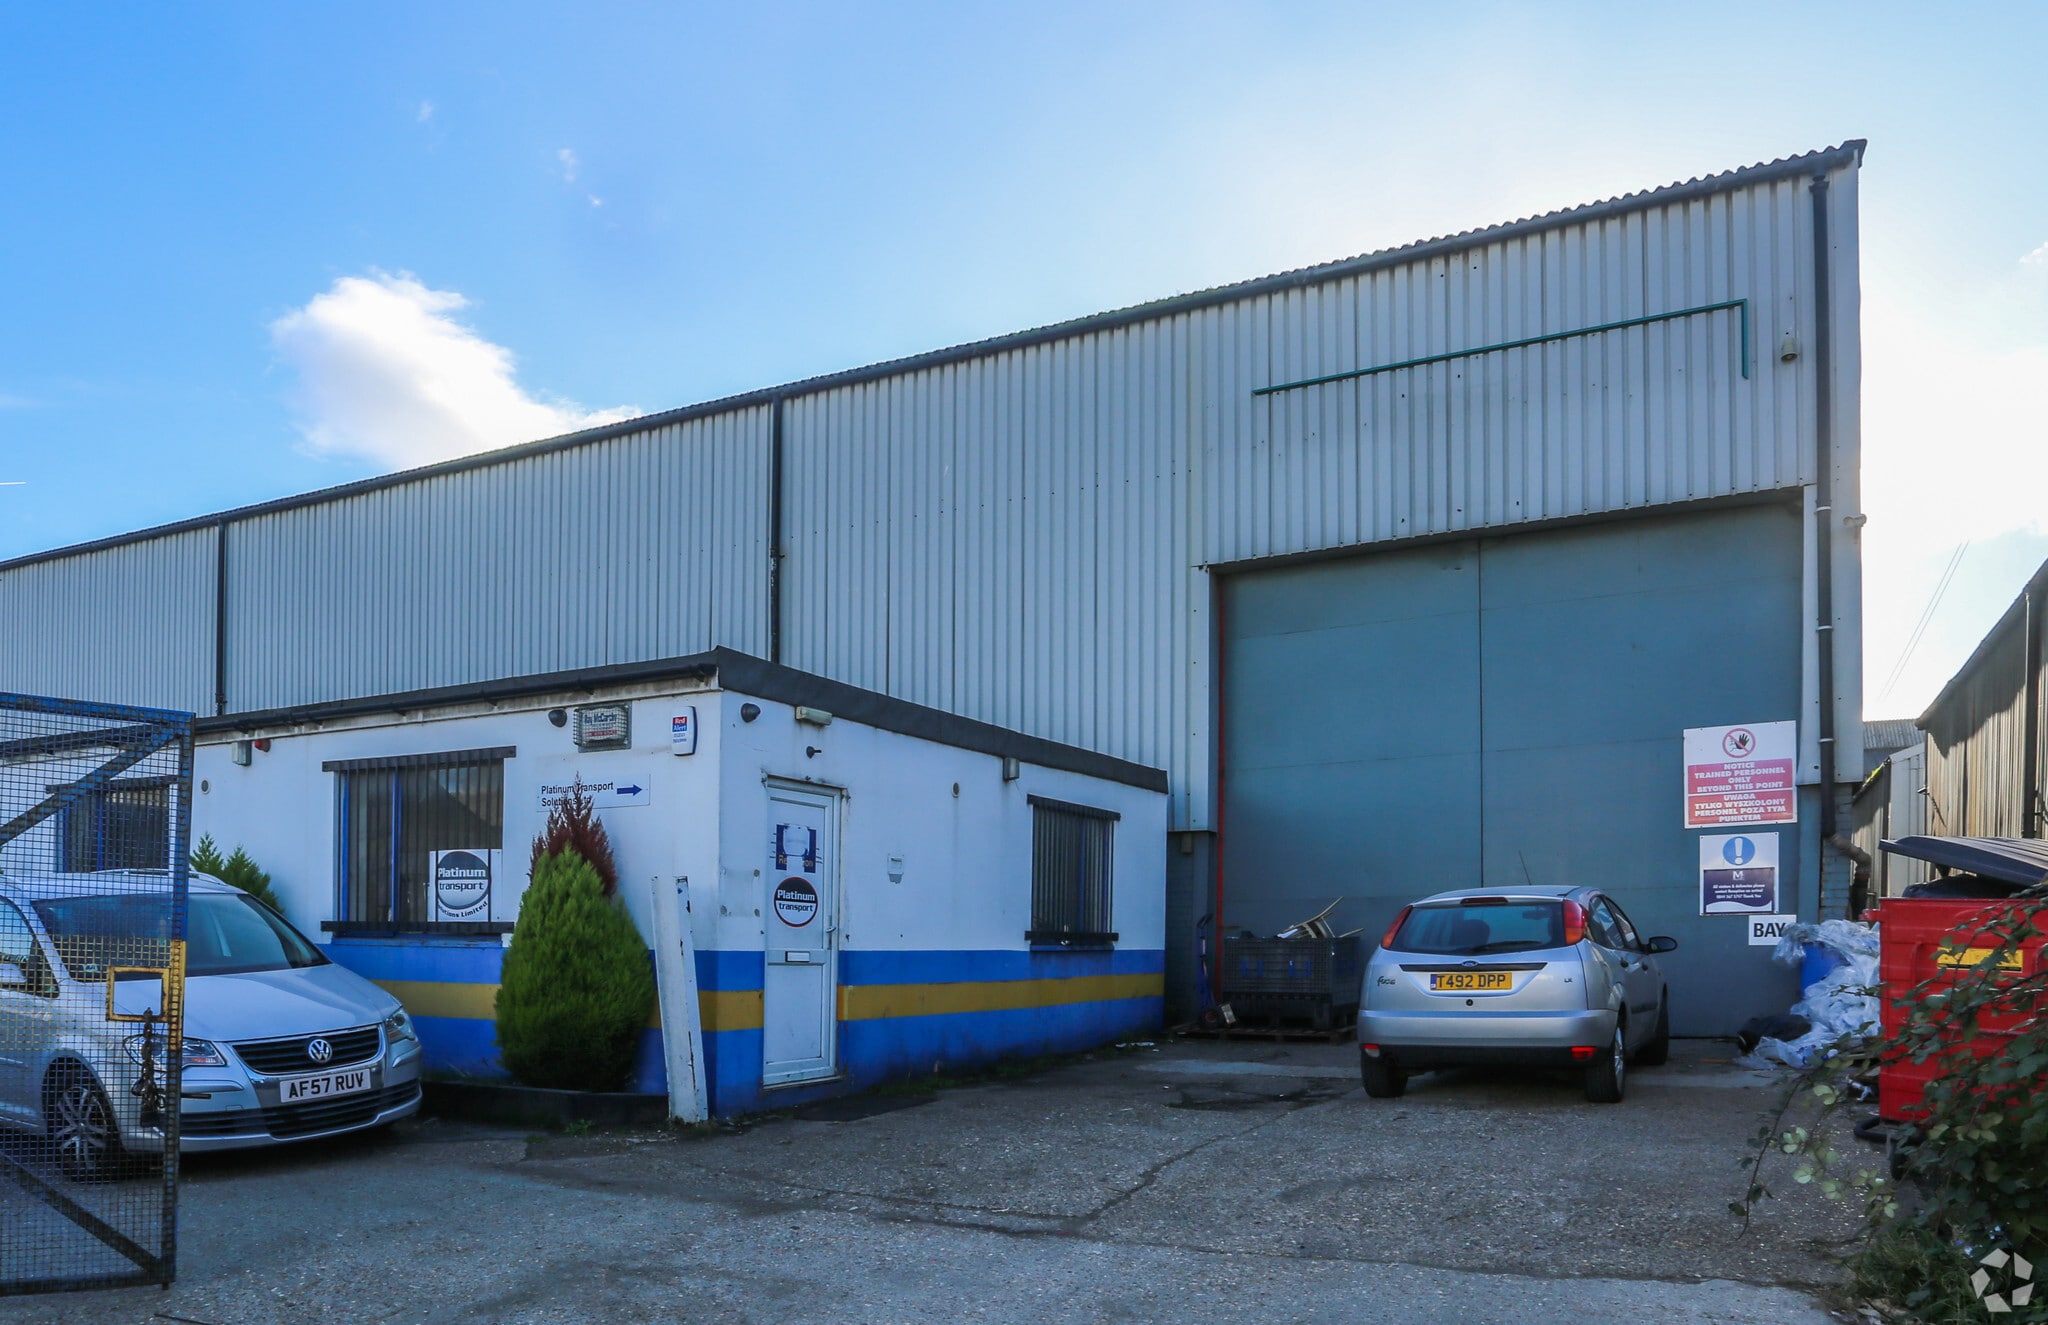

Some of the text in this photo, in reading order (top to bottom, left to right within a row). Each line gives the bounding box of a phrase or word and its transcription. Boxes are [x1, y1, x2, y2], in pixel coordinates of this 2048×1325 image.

[1724, 762, 1755, 770] NOTICE
[1694, 767, 1785, 779] TRAINED PERSONNEL
[541, 785, 574, 794] Platinum
[1697, 784, 1731, 792] BEYOND
[1756, 781, 1784, 789] POINT
[541, 797, 578, 807] Solutns
[1723, 793, 1756, 801] UWAGA
[1725, 798, 1786, 808] WYSZKOLONY
[1695, 808, 1738, 816] PERSONEL
[1719, 814, 1761, 822] PUNKTEM
[438, 867, 486, 878] Platinum
[439, 882, 485, 892] transport
[777, 889, 815, 901] Platinum
[778, 902, 813, 912] transport
[1753, 922, 1786, 937] BAY
[1436, 974, 1506, 988] T492 DPP
[288, 1071, 364, 1099] AF57 RUV
